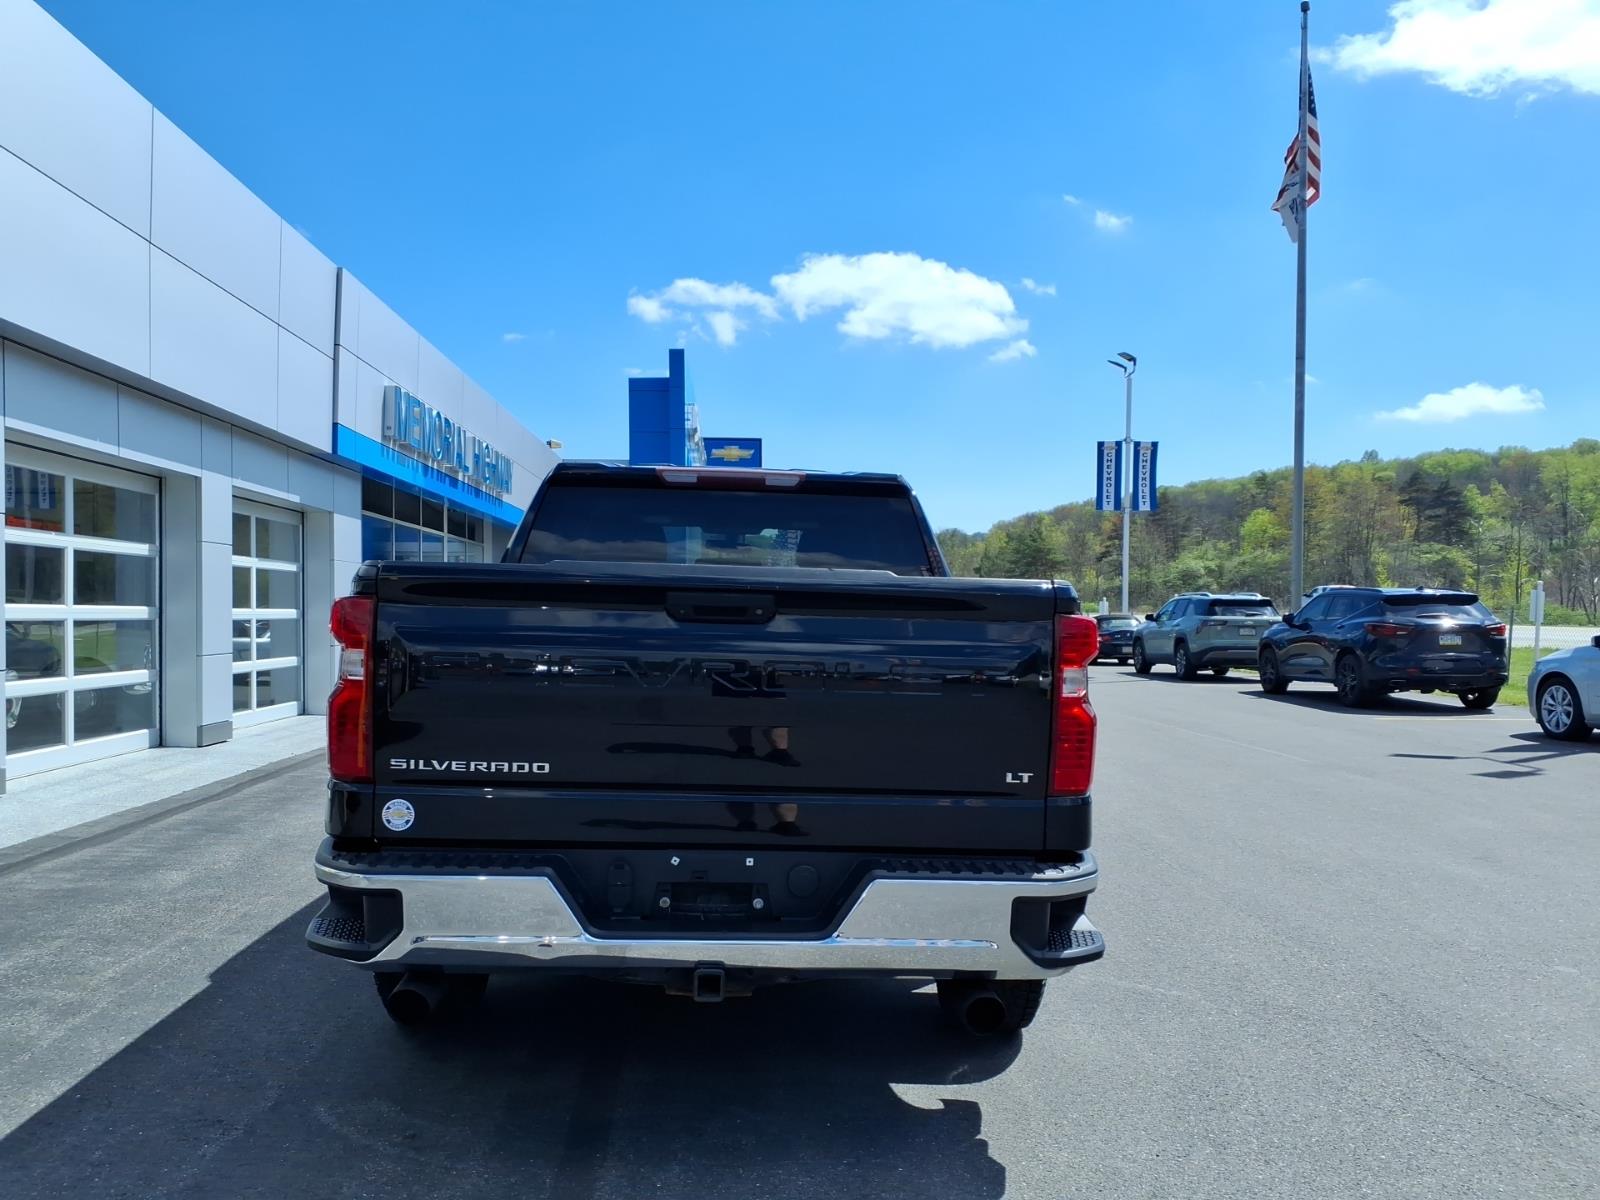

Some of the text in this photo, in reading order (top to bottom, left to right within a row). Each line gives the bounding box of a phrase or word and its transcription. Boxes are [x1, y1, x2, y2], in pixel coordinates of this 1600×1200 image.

[1105, 452, 1113, 506] CHEVROLET
[1140, 452, 1148, 506] CHEVROLET
[389, 758, 551, 774] SILVERADO
[1005, 772, 1034, 784] LT
